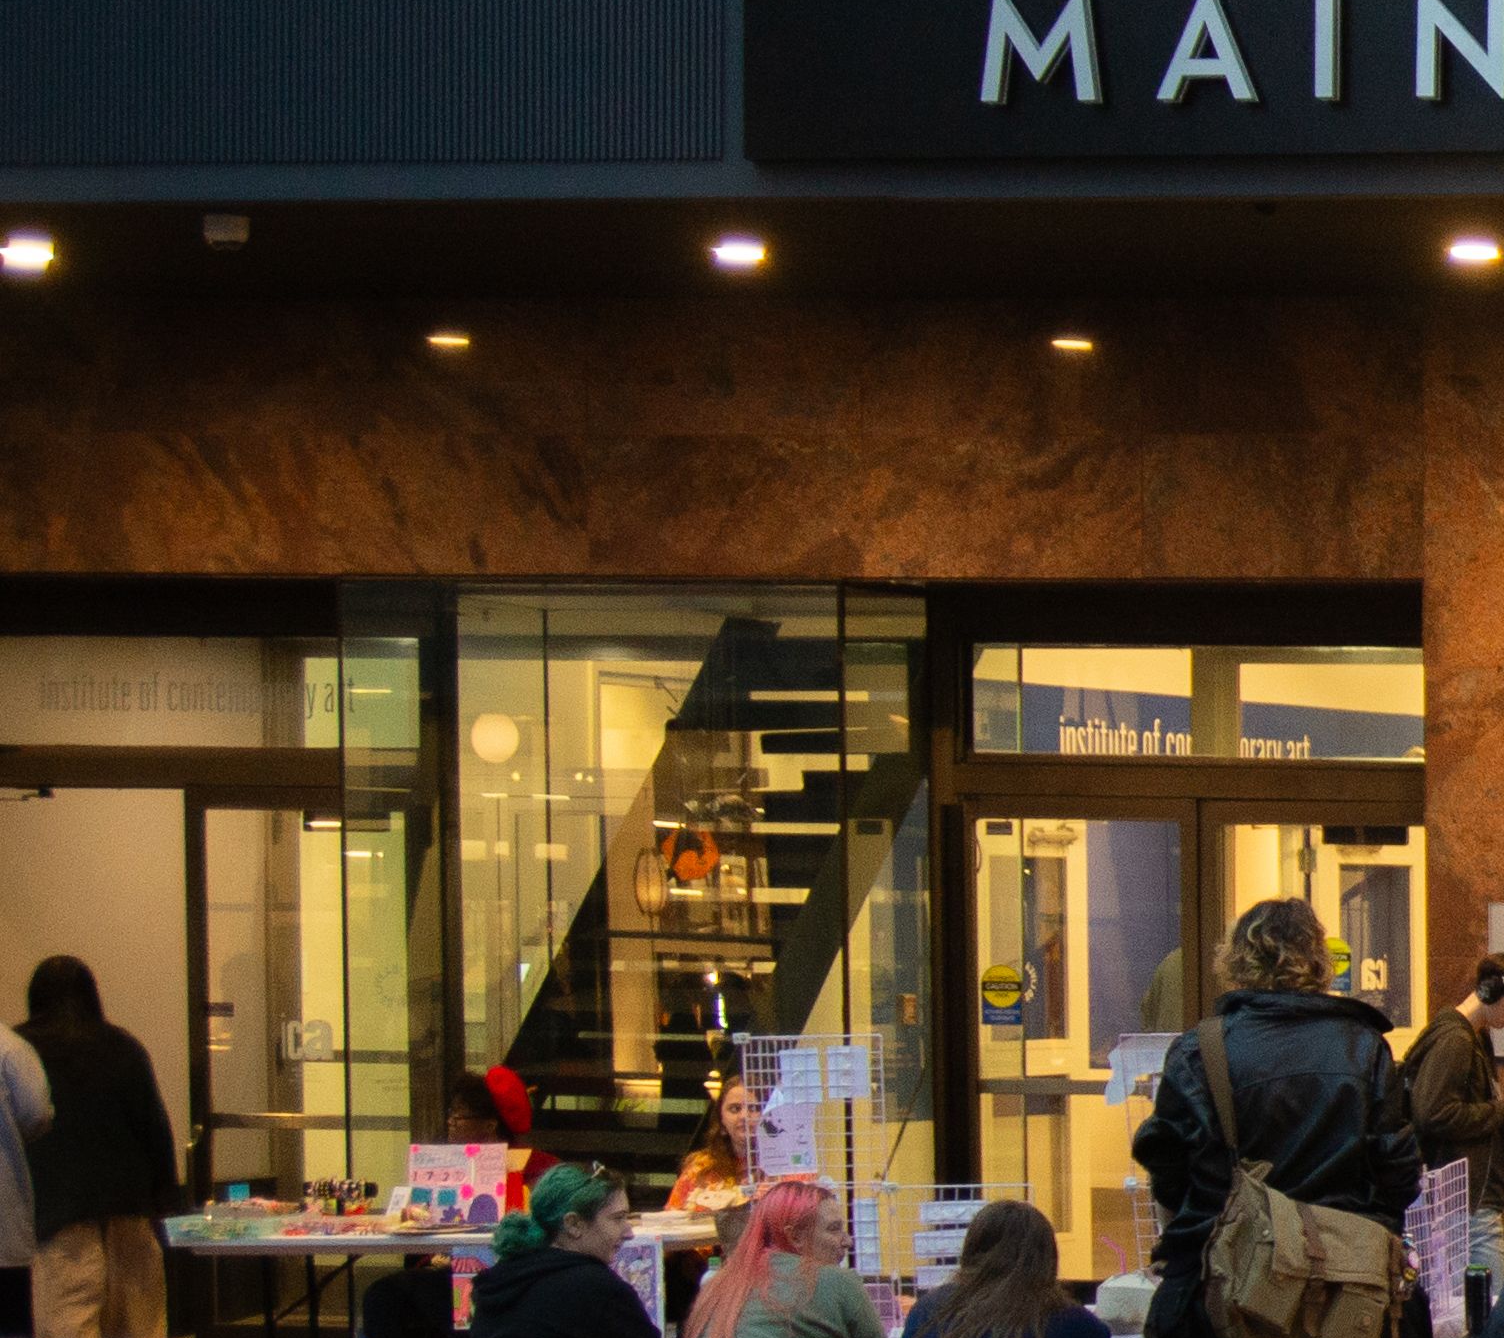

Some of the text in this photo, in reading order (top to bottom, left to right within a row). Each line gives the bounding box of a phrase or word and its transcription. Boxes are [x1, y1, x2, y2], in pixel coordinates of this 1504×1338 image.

[39, 673, 131, 713] institute
[137, 671, 160, 713] of
[321, 674, 356, 714] at
[1059, 714, 1138, 755] institute
[1142, 717, 1162, 755] of
[1286, 733, 1312, 759] art
[280, 1012, 334, 1062] ica
